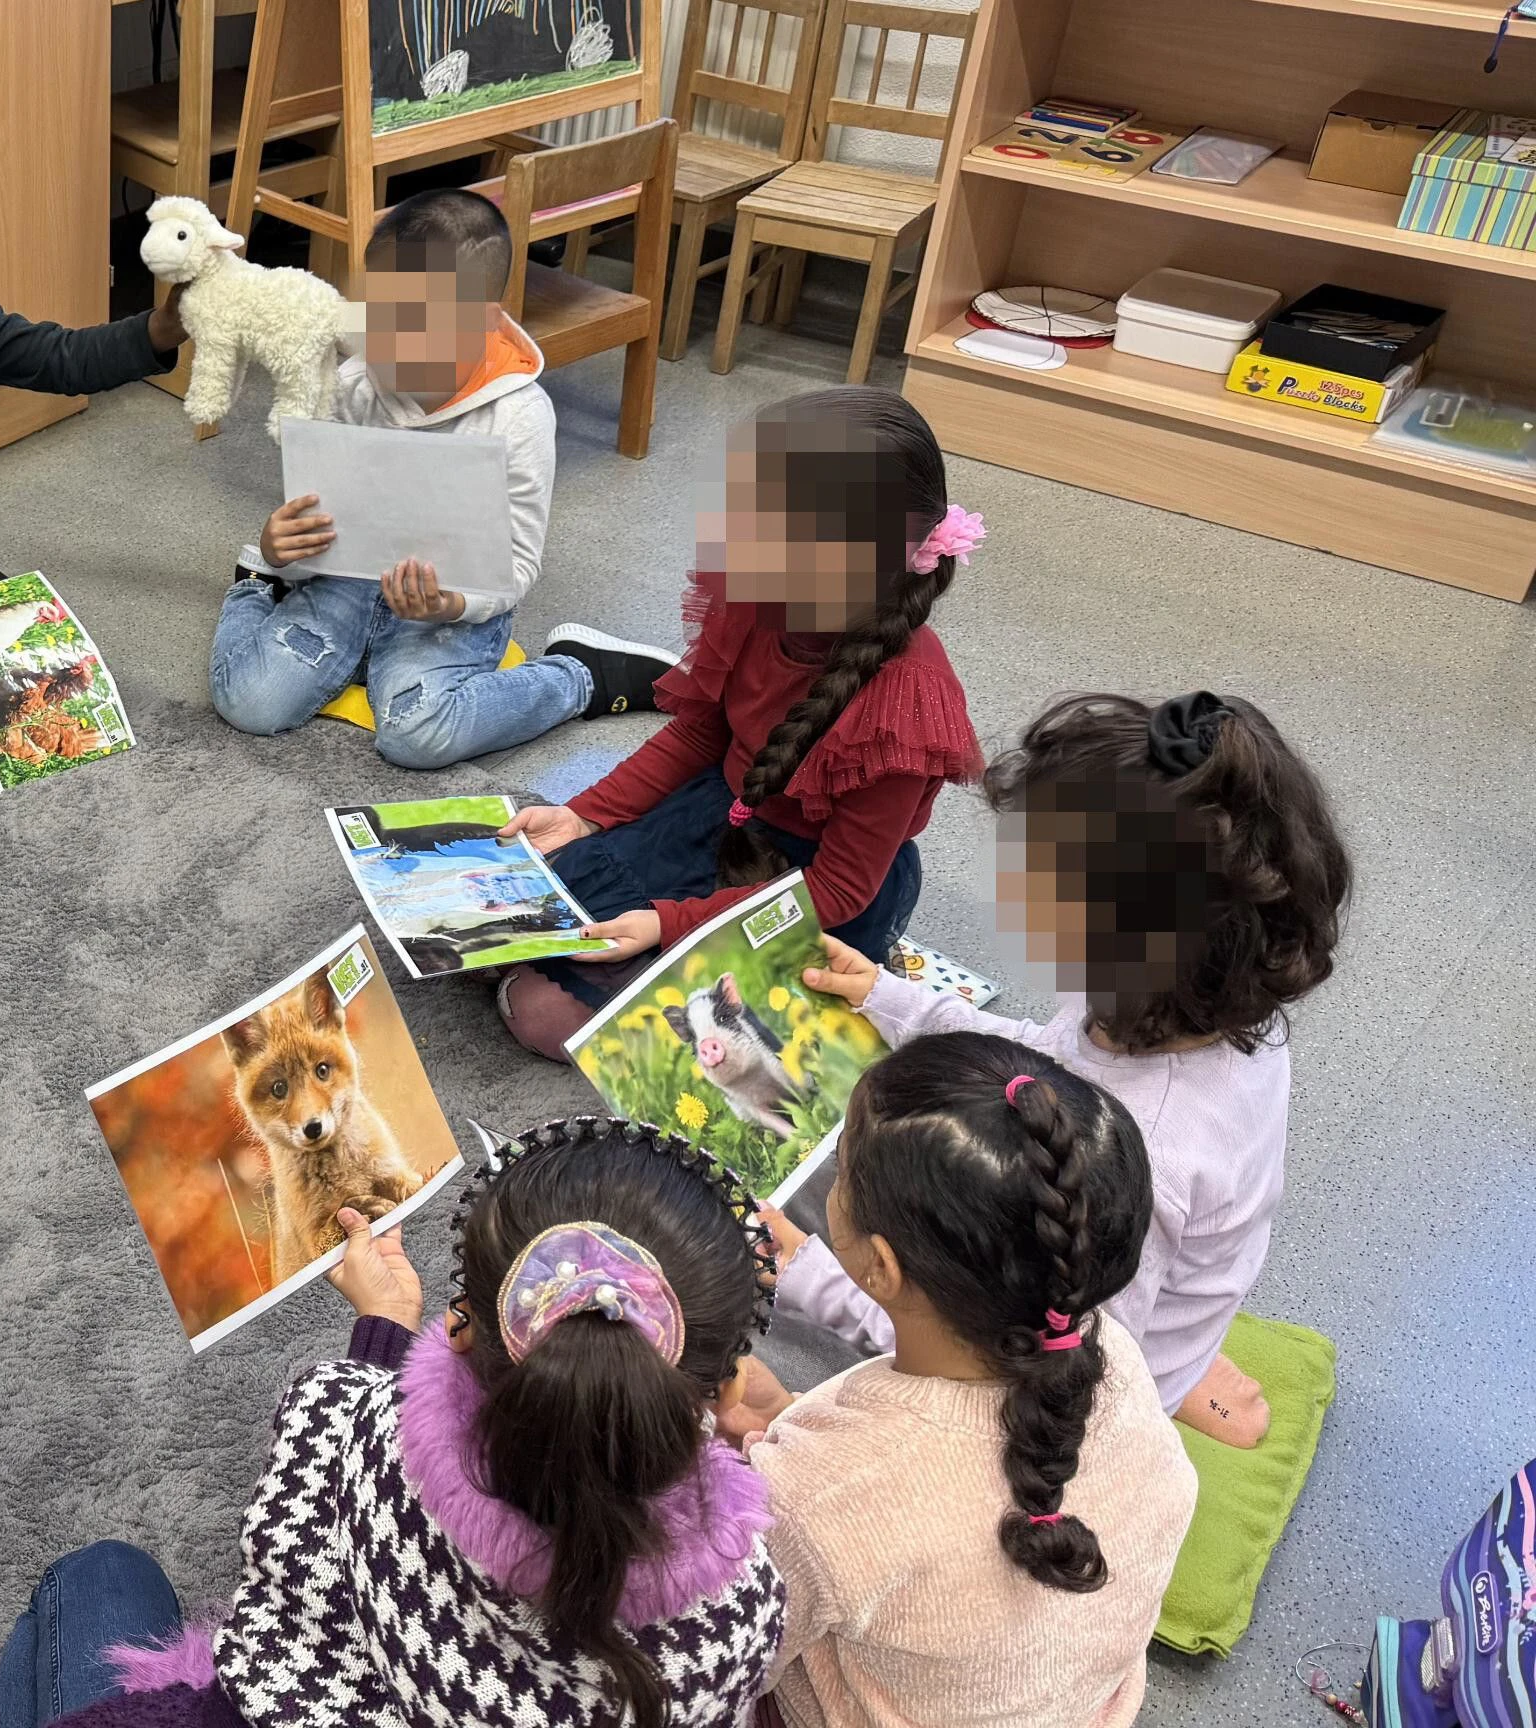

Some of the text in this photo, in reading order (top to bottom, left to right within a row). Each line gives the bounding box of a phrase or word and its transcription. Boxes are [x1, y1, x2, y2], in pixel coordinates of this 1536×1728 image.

[1277, 376, 1367, 414] Puzzle Blocks
[1319, 380, 1364, 399] 125pcs
